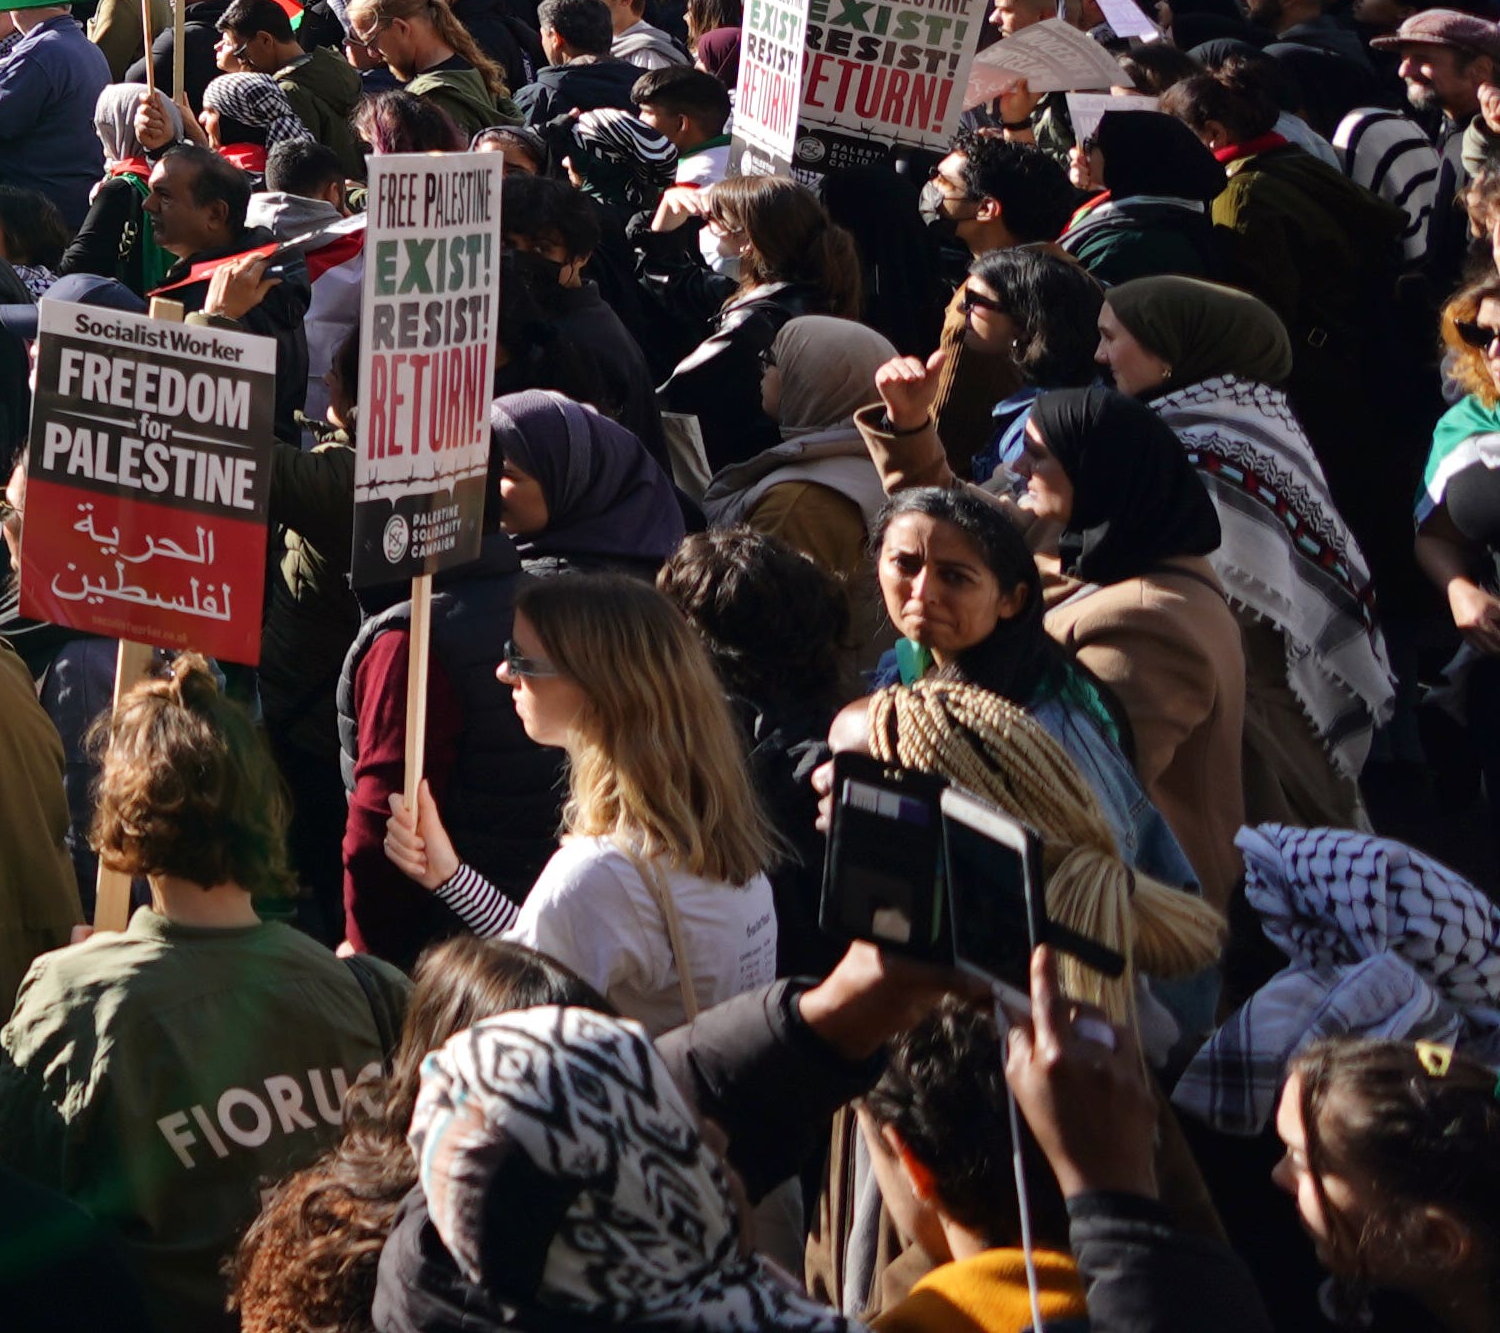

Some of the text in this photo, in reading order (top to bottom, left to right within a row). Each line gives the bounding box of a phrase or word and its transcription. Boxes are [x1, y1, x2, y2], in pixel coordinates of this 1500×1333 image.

[747, 31, 798, 79] RESIST!
[740, 59, 796, 138] RETURN!
[377, 168, 493, 230] FREE PALESTINE
[374, 232, 492, 297] EXIST!
[74, 313, 245, 363] Socialist Worker
[372, 294, 490, 352] RESIST!
[57, 347, 252, 431] FREEDOM
[367, 343, 488, 462] RETURN!
[139, 413, 173, 442] for
[42, 421, 257, 511] PALESTINE
[73, 502, 215, 566] الحرية
[411, 517, 462, 542] SOLIDARITY
[412, 503, 459, 527] PALESTINE
[410, 536, 456, 559] CAMPAIGN
[50, 560, 232, 622] لفلسطين
